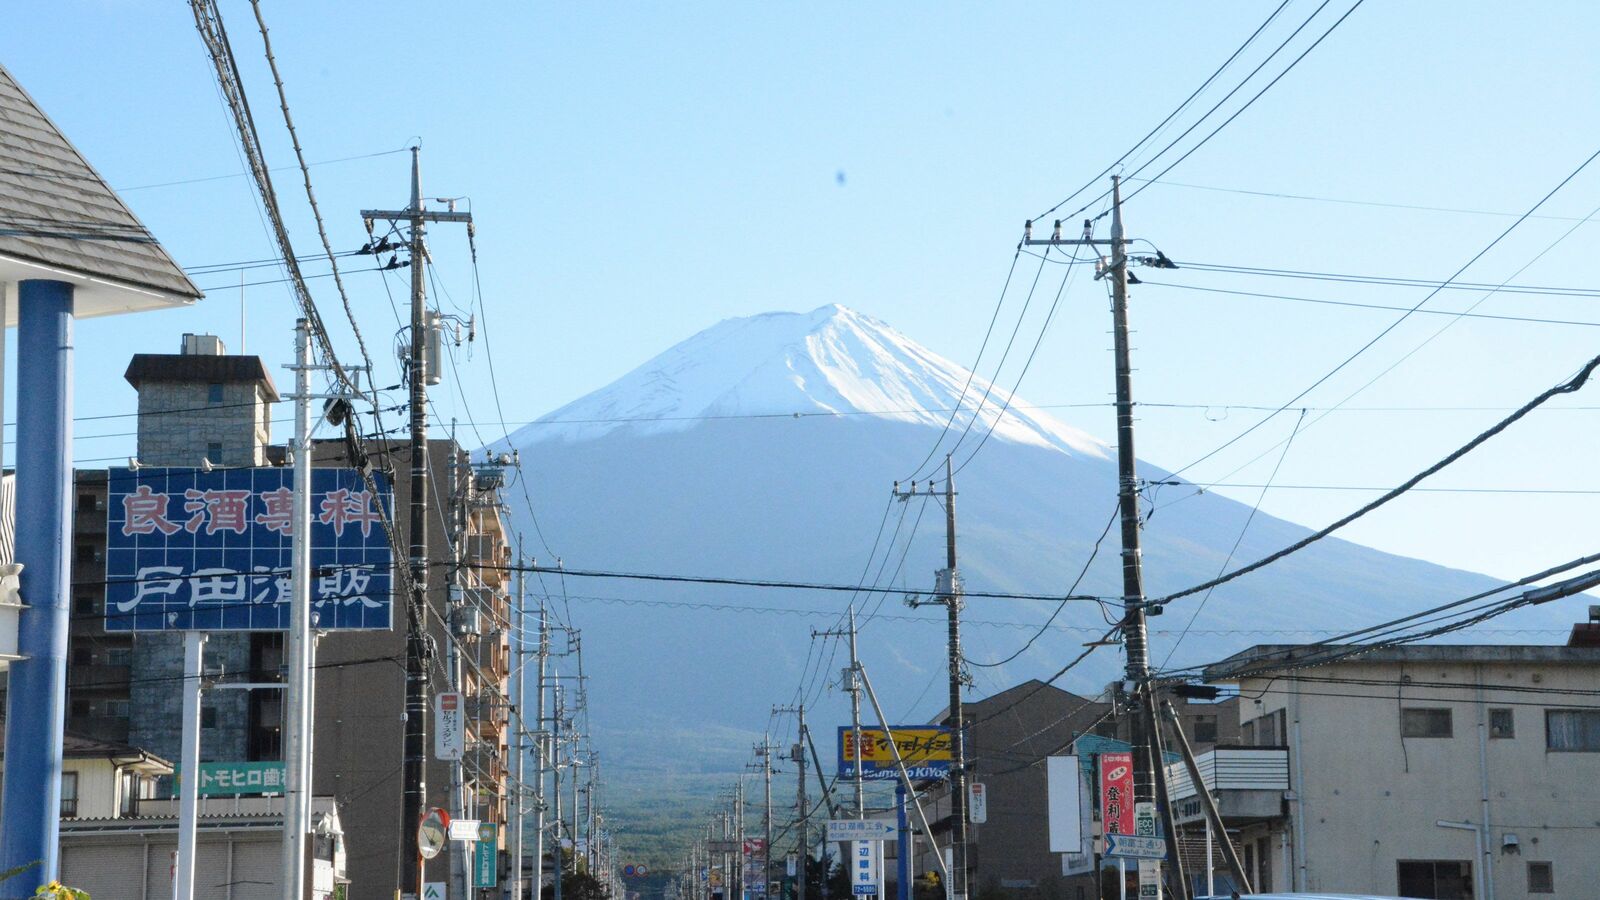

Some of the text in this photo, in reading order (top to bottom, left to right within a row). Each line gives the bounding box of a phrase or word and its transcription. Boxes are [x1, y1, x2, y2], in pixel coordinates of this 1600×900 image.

[845, 767, 913, 778] Mtsumoo
[201, 768, 287, 789] トモヒロ歯
[1138, 820, 1152, 829] ECC
